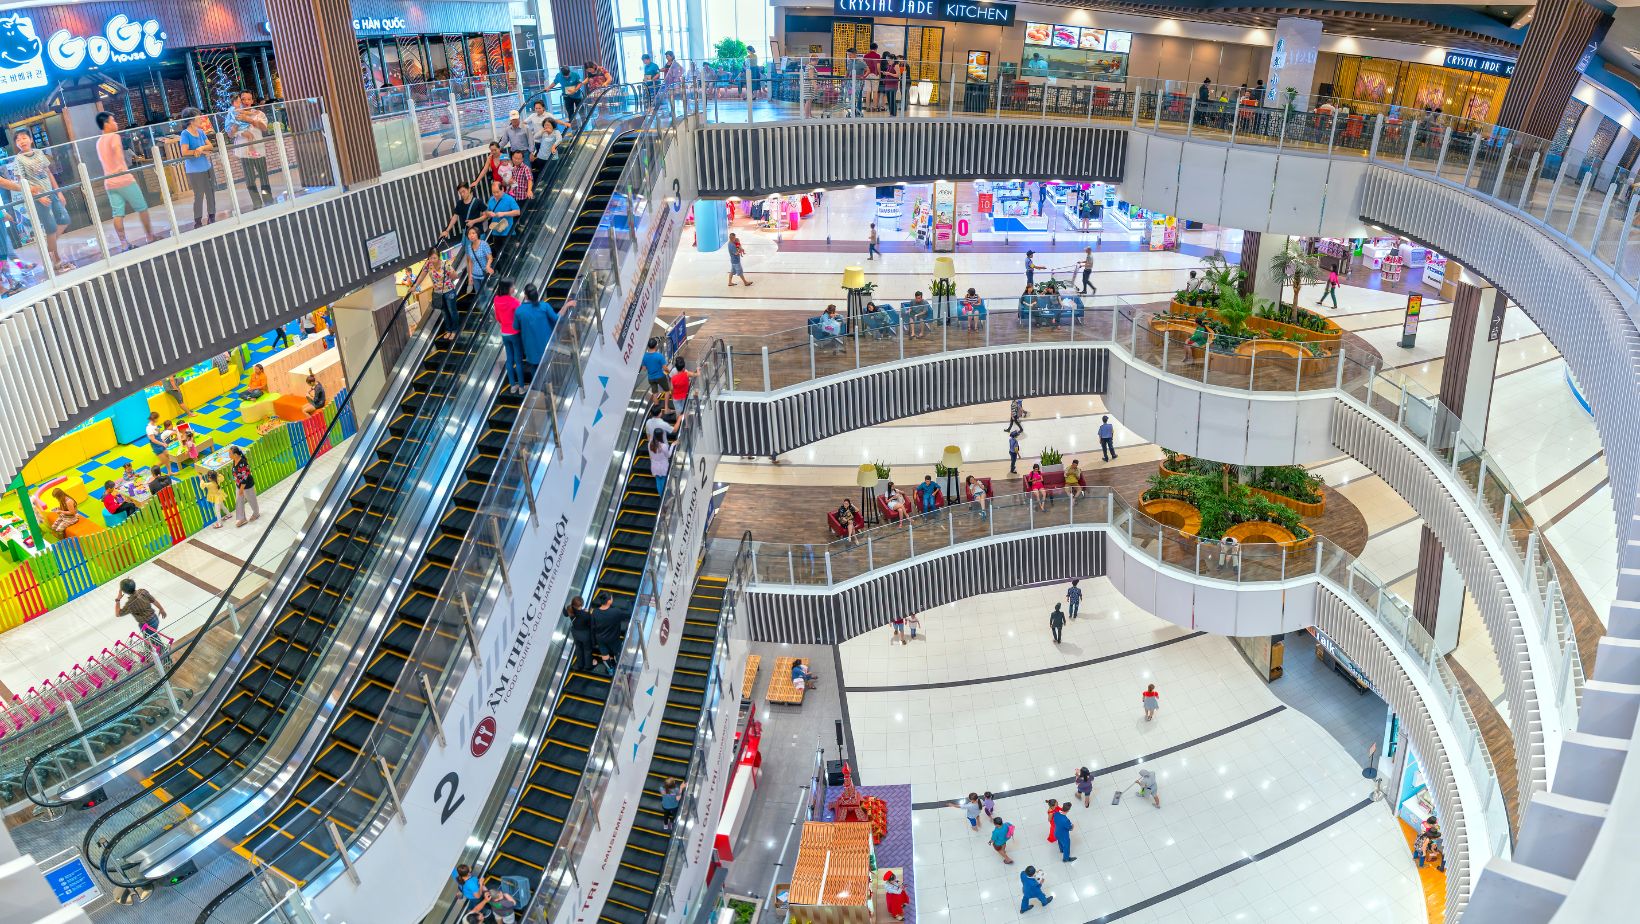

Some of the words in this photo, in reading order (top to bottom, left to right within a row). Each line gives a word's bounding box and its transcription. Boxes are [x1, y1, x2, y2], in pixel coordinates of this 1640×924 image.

[363, 17, 380, 30] HÀN
[382, 17, 406, 31] QUỐC
[840, 0, 893, 12] CRYSTAL
[900, 0, 933, 15] JADE
[946, 4, 1008, 21] KITCHEN
[111, 51, 146, 63] house
[1447, 55, 1477, 69] CRYSTAL
[1480, 60, 1501, 72] JADE
[672, 178, 682, 213] 3
[699, 456, 708, 489] 2
[486, 673, 510, 714] ẨM
[505, 603, 537, 669] THỰC
[533, 551, 554, 602] PHỐ
[550, 513, 569, 554] HỘI
[504, 675, 518, 703] FOOD
[517, 642, 532, 673] COURT
[532, 616, 542, 632] OLD
[541, 569, 558, 615] QUARTER
[556, 537, 569, 569] DINING
[433, 771, 466, 825] 2
[581, 881, 599, 912] TRÍ
[601, 800, 628, 870] AMUSEMENT
